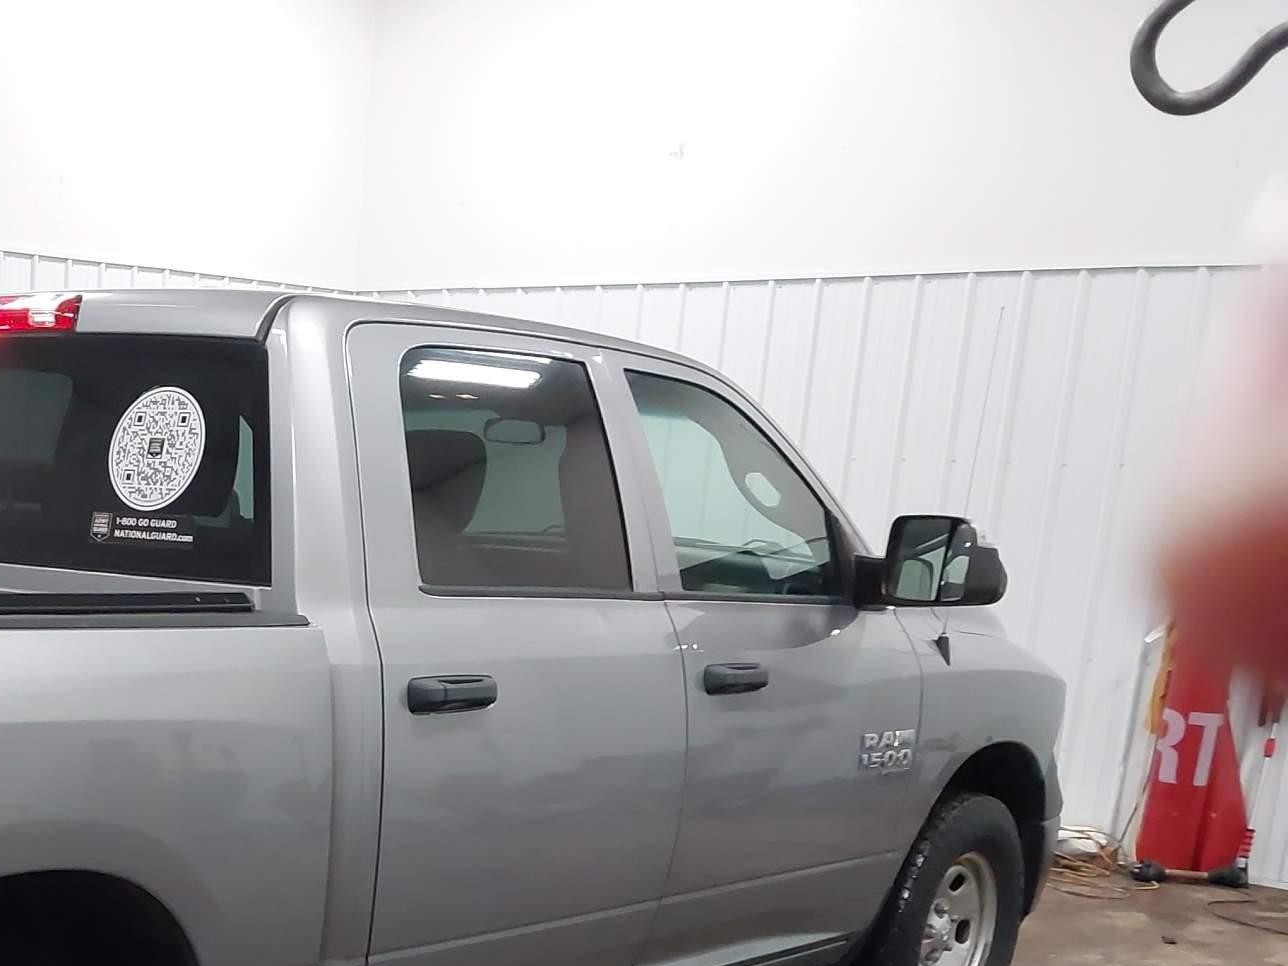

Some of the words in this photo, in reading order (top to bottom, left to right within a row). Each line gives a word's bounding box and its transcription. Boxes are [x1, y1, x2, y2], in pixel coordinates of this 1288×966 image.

[116, 517, 137, 526] 1-800
[138, 518, 149, 527] GO
[150, 518, 177, 528] GUARD
